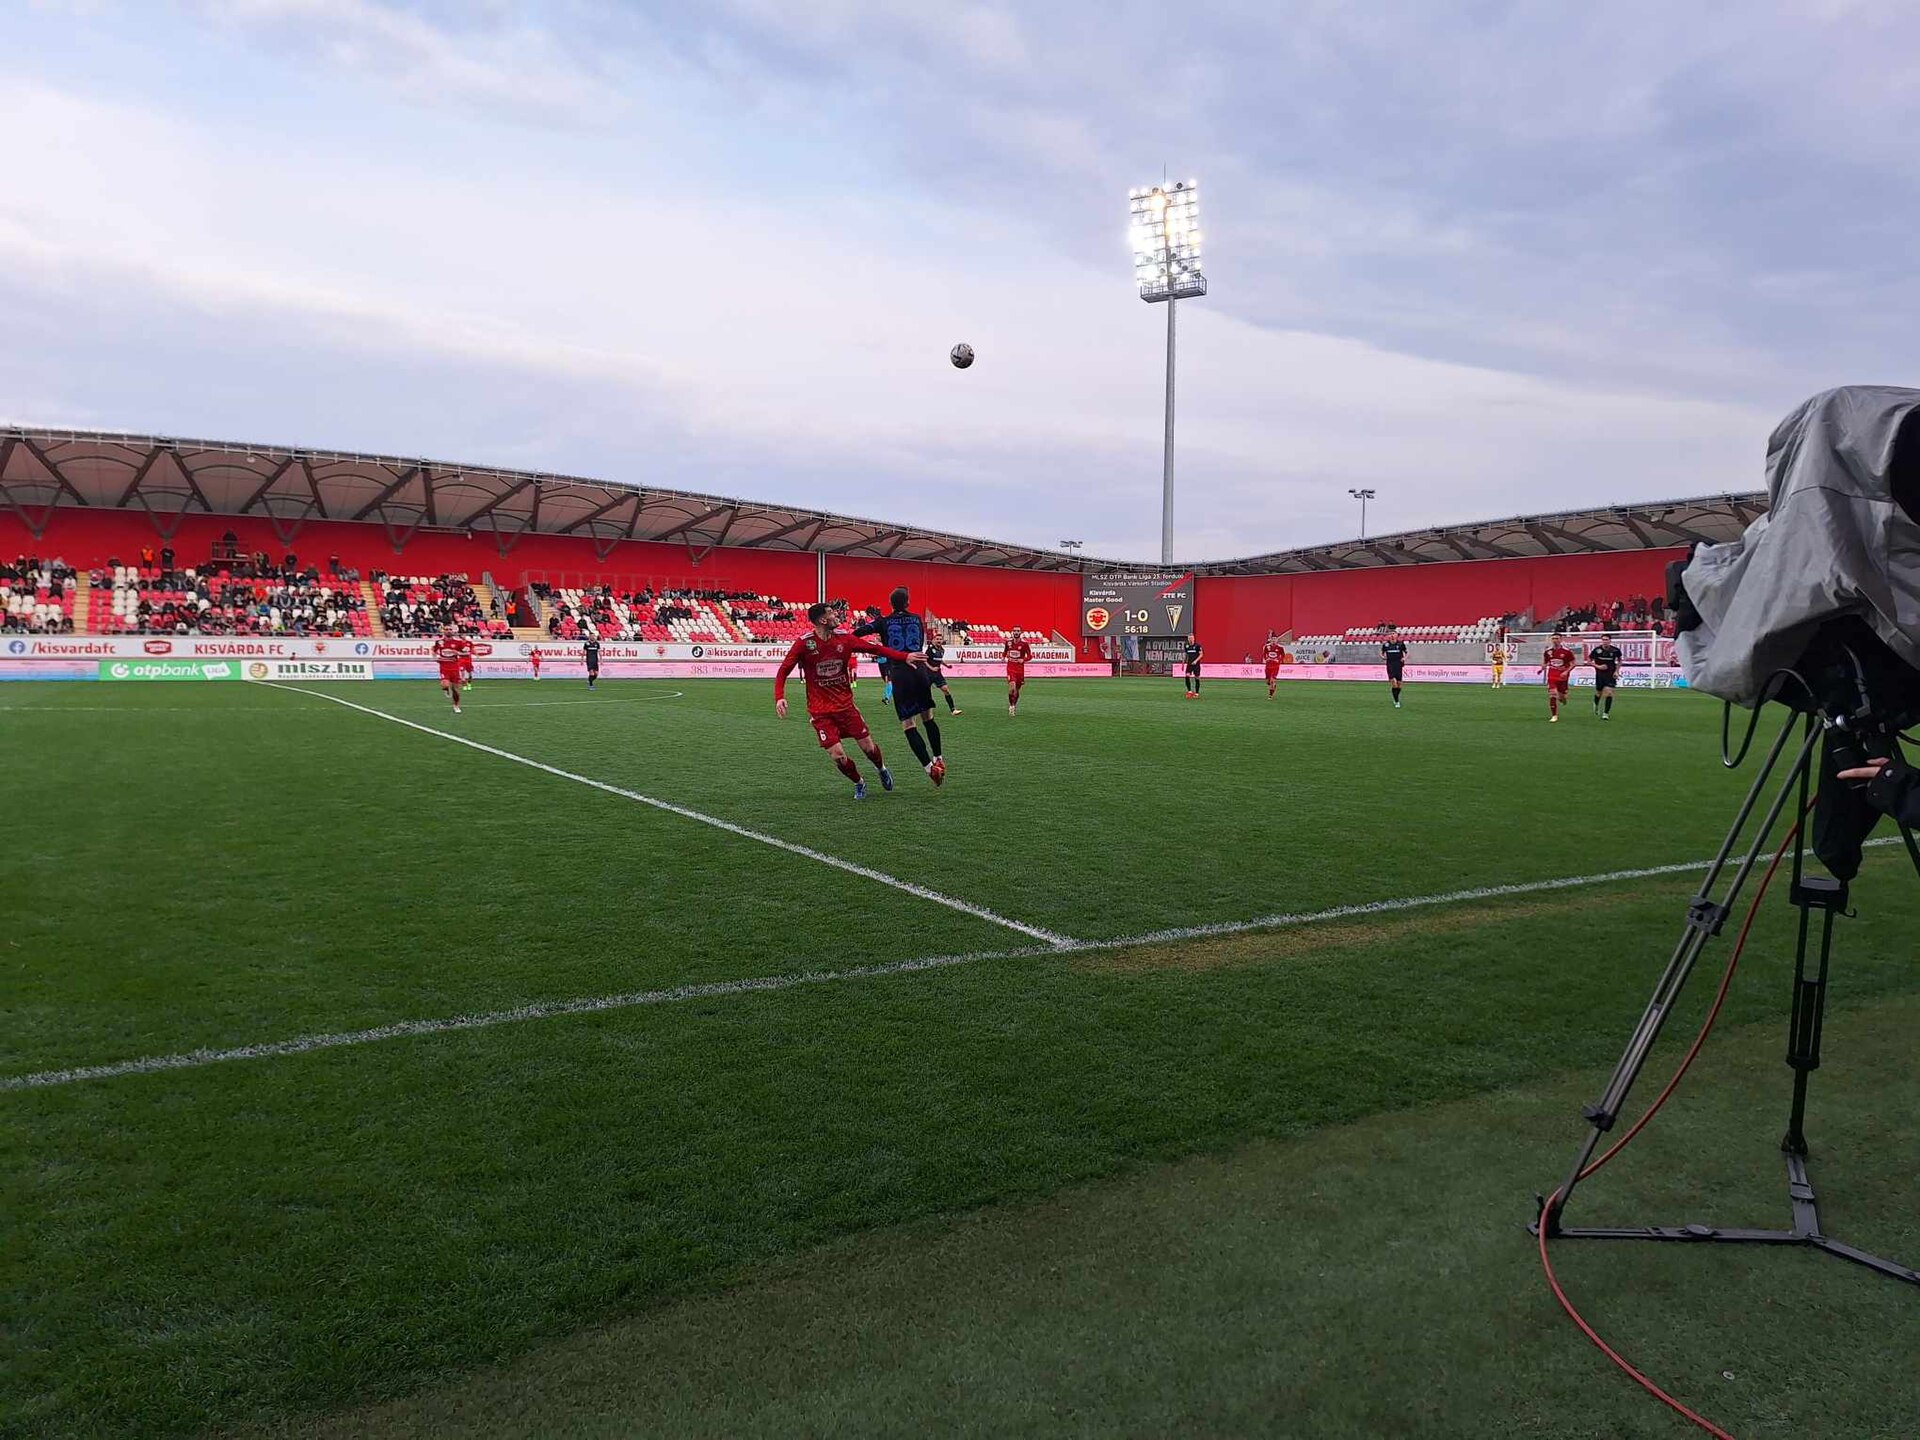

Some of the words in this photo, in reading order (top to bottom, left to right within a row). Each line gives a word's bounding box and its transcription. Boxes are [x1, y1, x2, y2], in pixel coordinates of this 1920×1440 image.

[1124, 610, 1148, 622] 1-0
[31, 642, 116, 654] /kisvardafc
[269, 645, 284, 654] FC
[372, 644, 430, 656] /kisvarda
[133, 662, 200, 679] otpbank
[819, 729, 826, 741] 6
